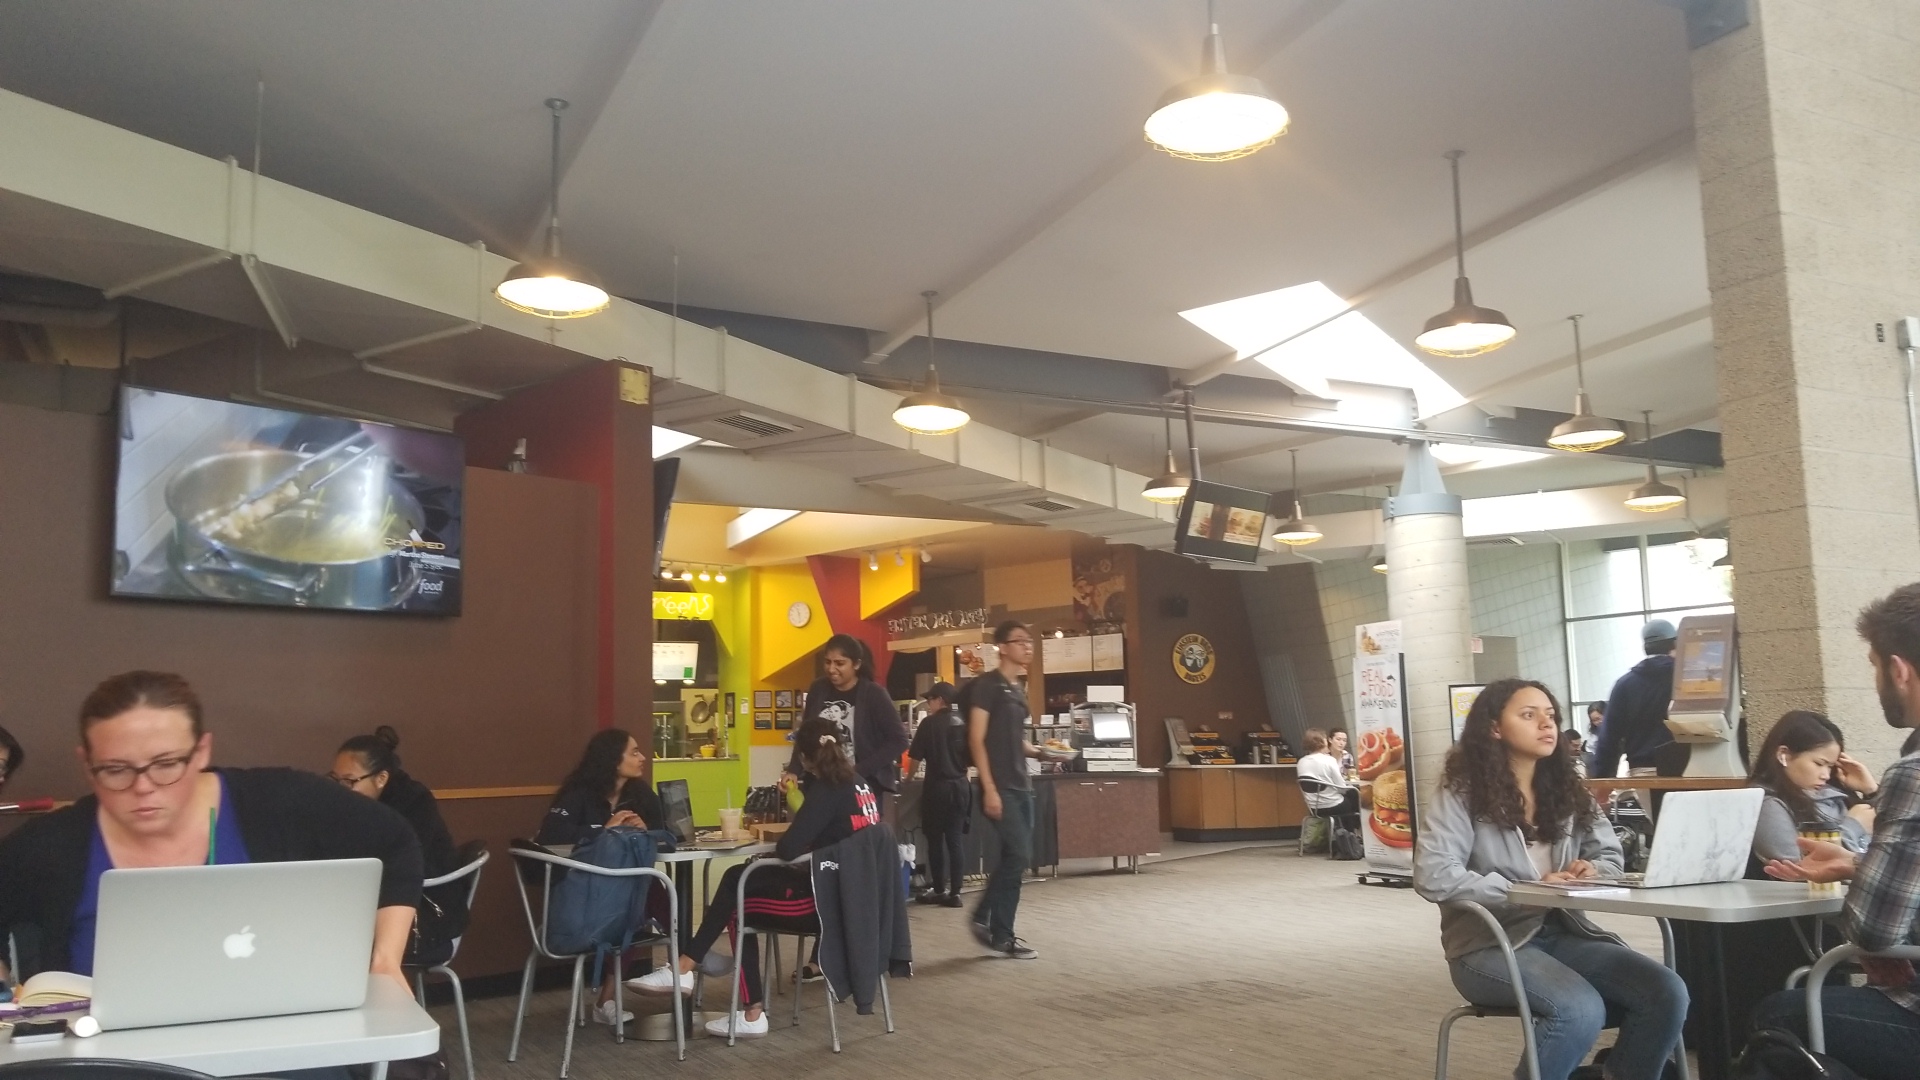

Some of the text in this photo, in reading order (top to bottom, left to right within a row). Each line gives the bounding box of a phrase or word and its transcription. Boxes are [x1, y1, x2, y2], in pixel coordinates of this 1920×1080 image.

[417, 578, 444, 595] food
[1361, 668, 1386, 684] REAL
[1368, 683, 1394, 698] FOOD
